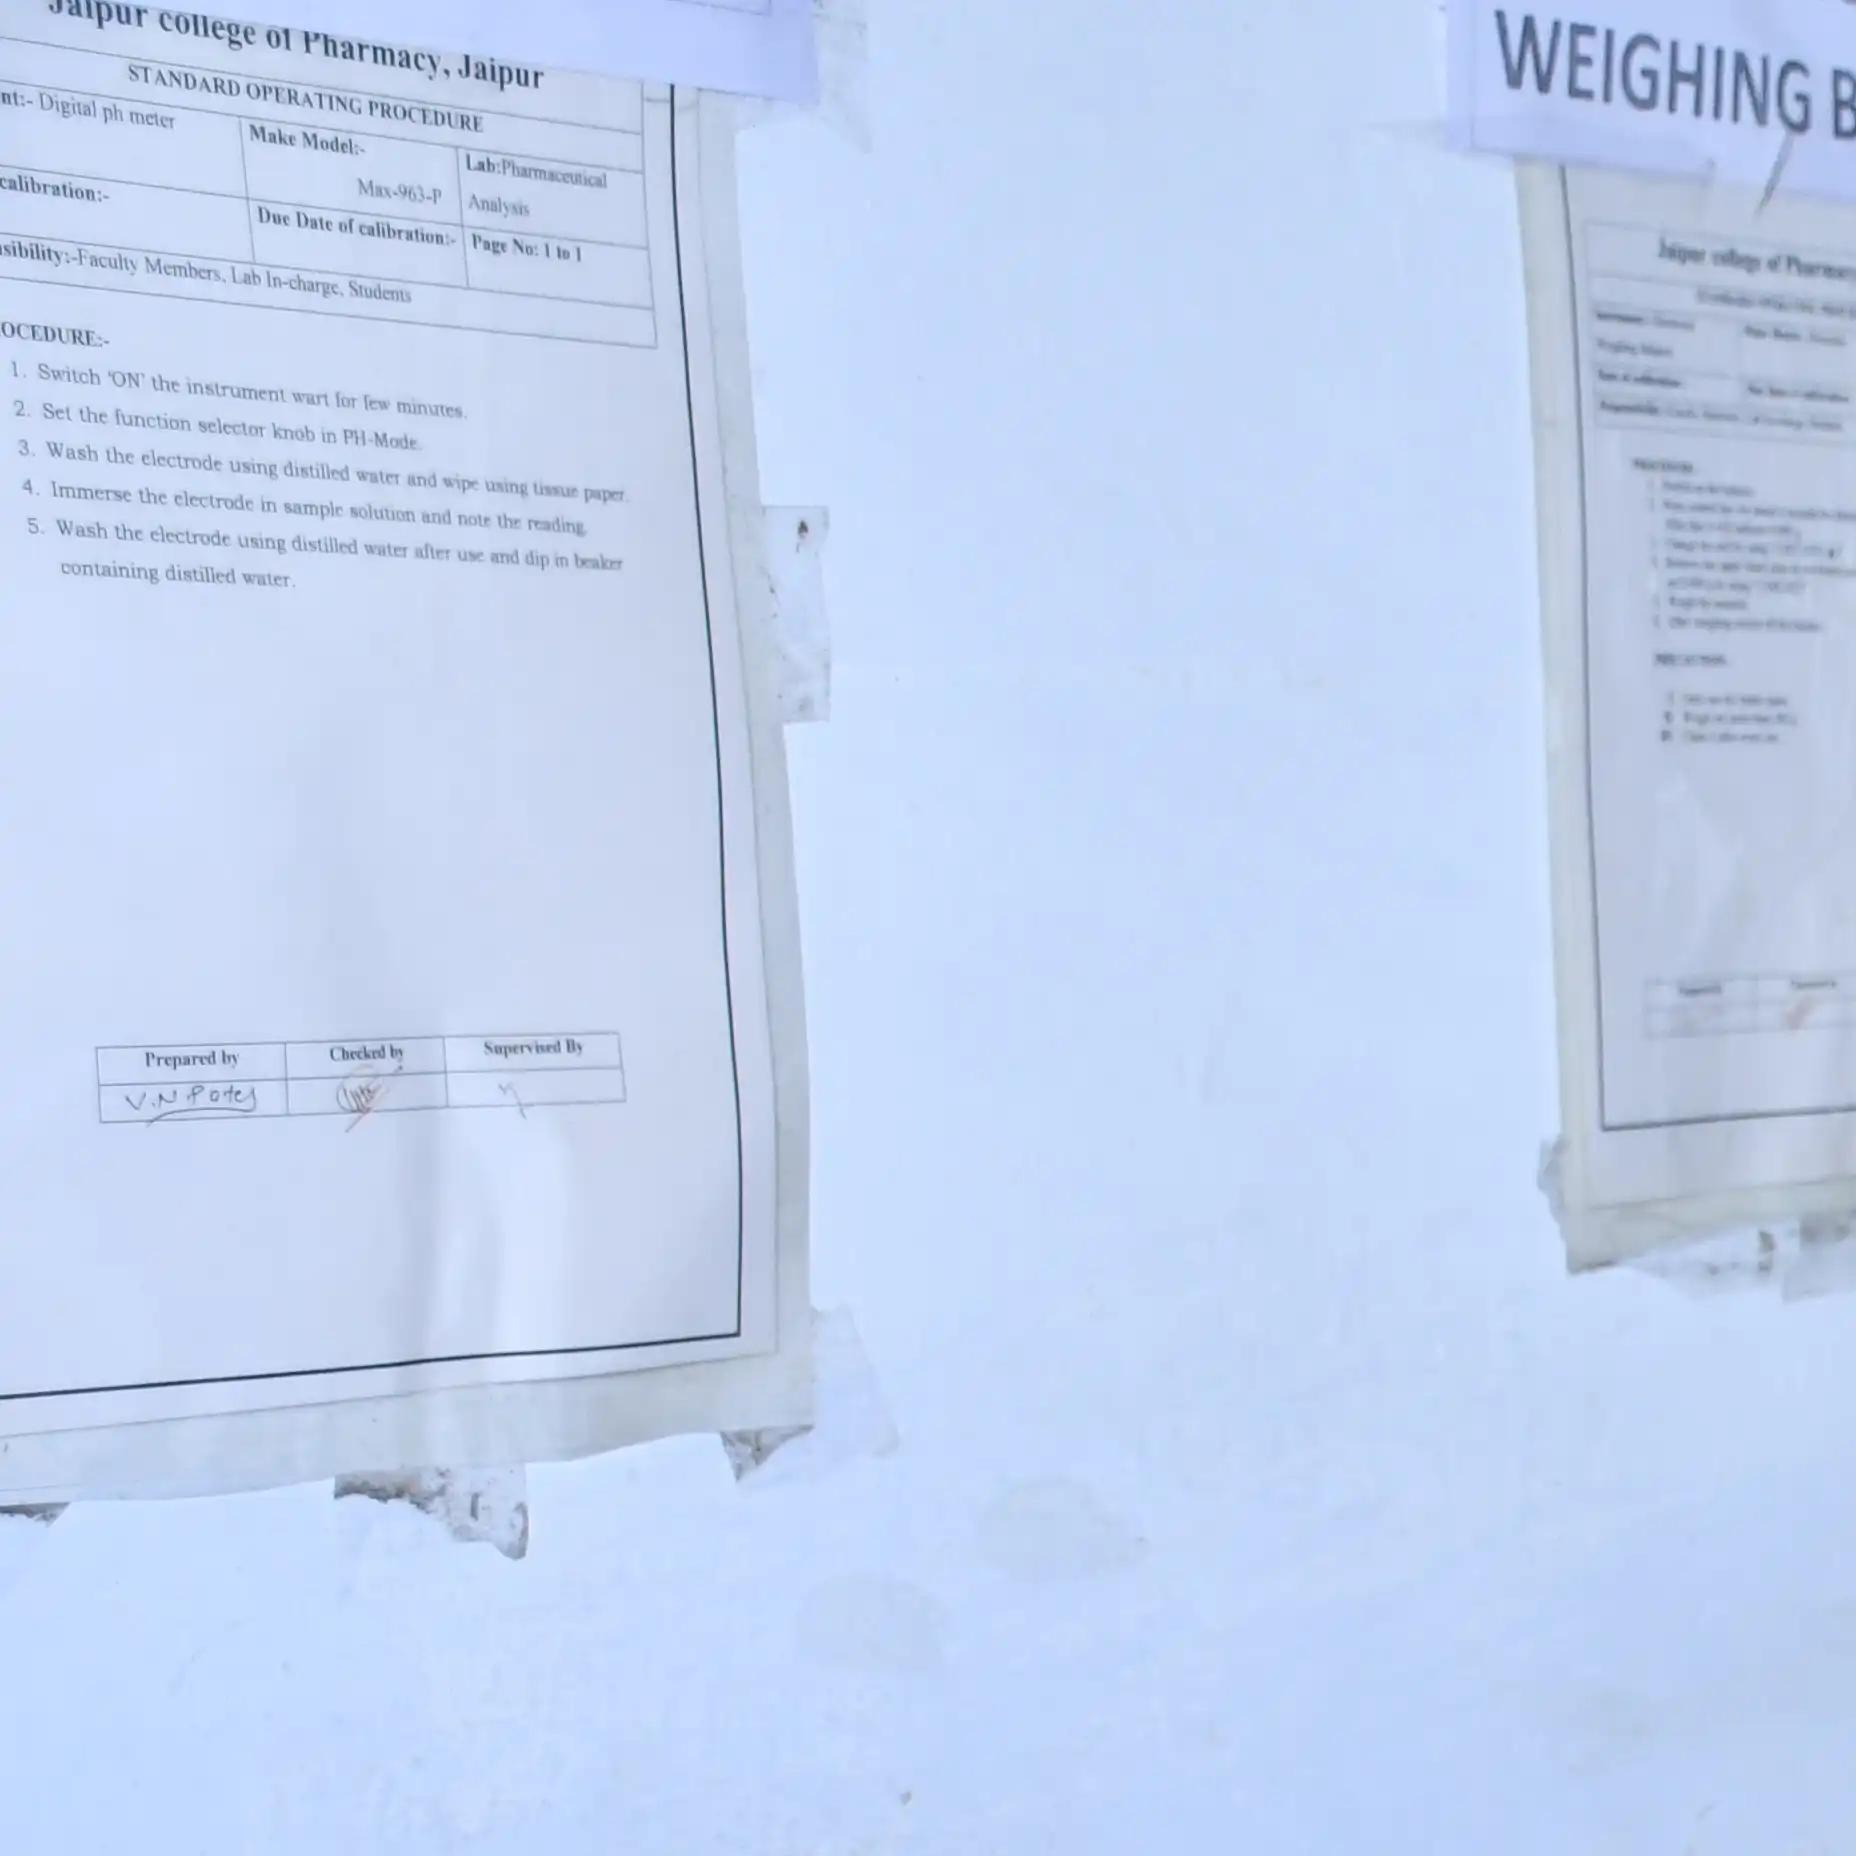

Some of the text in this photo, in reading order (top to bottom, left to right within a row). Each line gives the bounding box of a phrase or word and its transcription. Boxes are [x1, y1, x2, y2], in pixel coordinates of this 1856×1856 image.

[158, 10, 256, 51] college
[304, 30, 451, 80] Pharmacy,
[457, 53, 545, 92] Jaipur
[1495, 10, 1813, 134] WEIGHING
[40, 92, 97, 118] Digital
[103, 104, 124, 124] ph
[130, 112, 175, 129] meter
[128, 64, 484, 133] STANDARD OPERATING PROCEDURE
[249, 124, 366, 156] Make Model:-
[358, 178, 442, 205] Max-963-P
[468, 195, 531, 218] Analysis
[258, 206, 457, 246] Due Date of calibration:-
[471, 234, 507, 256] Page
[513, 239, 539, 257] No:
[557, 245, 571, 261] to
[146, 257, 227, 284] Members,
[231, 267, 261, 286] Lab
[349, 279, 413, 303] Students
[0, 322, 110, 348] OCEDURE:-
[11, 362, 26, 378] 1.
[38, 363, 101, 385] Switch
[152, 374, 180, 393] the
[187, 378, 286, 403] instrument
[335, 391, 357, 409] for
[364, 394, 390, 411] few
[397, 400, 467, 420] minutes.
[14, 400, 31, 417] 2.
[43, 403, 72, 422] Set
[80, 406, 107, 425] the
[115, 409, 191, 432] function
[199, 418, 266, 439] selector
[273, 422, 315, 443] knob
[322, 428, 337, 443] in
[18, 440, 35, 457] 3.
[47, 441, 99, 463] Wash
[106, 446, 134, 465] the
[142, 449, 222, 472] electrode
[230, 459, 278, 480] using
[284, 460, 350, 482] distilled
[356, 469, 400, 485] water
[407, 471, 437, 489] and
[442, 474, 478, 493] wipe
[485, 479, 528, 498] using
[533, 481, 578, 498] tissue
[22, 479, 40, 496] 4.
[50, 481, 131, 503] Immerse
[139, 487, 167, 506] the
[174, 491, 252, 512] electrode
[260, 496, 277, 513] in
[284, 499, 343, 520] sample
[349, 503, 415, 523] solution
[421, 508, 451, 525] and
[458, 511, 490, 527] note
[497, 513, 521, 530] the
[27, 518, 623, 572] 5. Wash the electrode using distilled water after use and dip in beaker
[61, 561, 296, 588] containing distilled water.
[145, 1050, 240, 1070] Prepared by
[329, 1043, 404, 1062] Checked by
[484, 1038, 583, 1058] Supervised By
